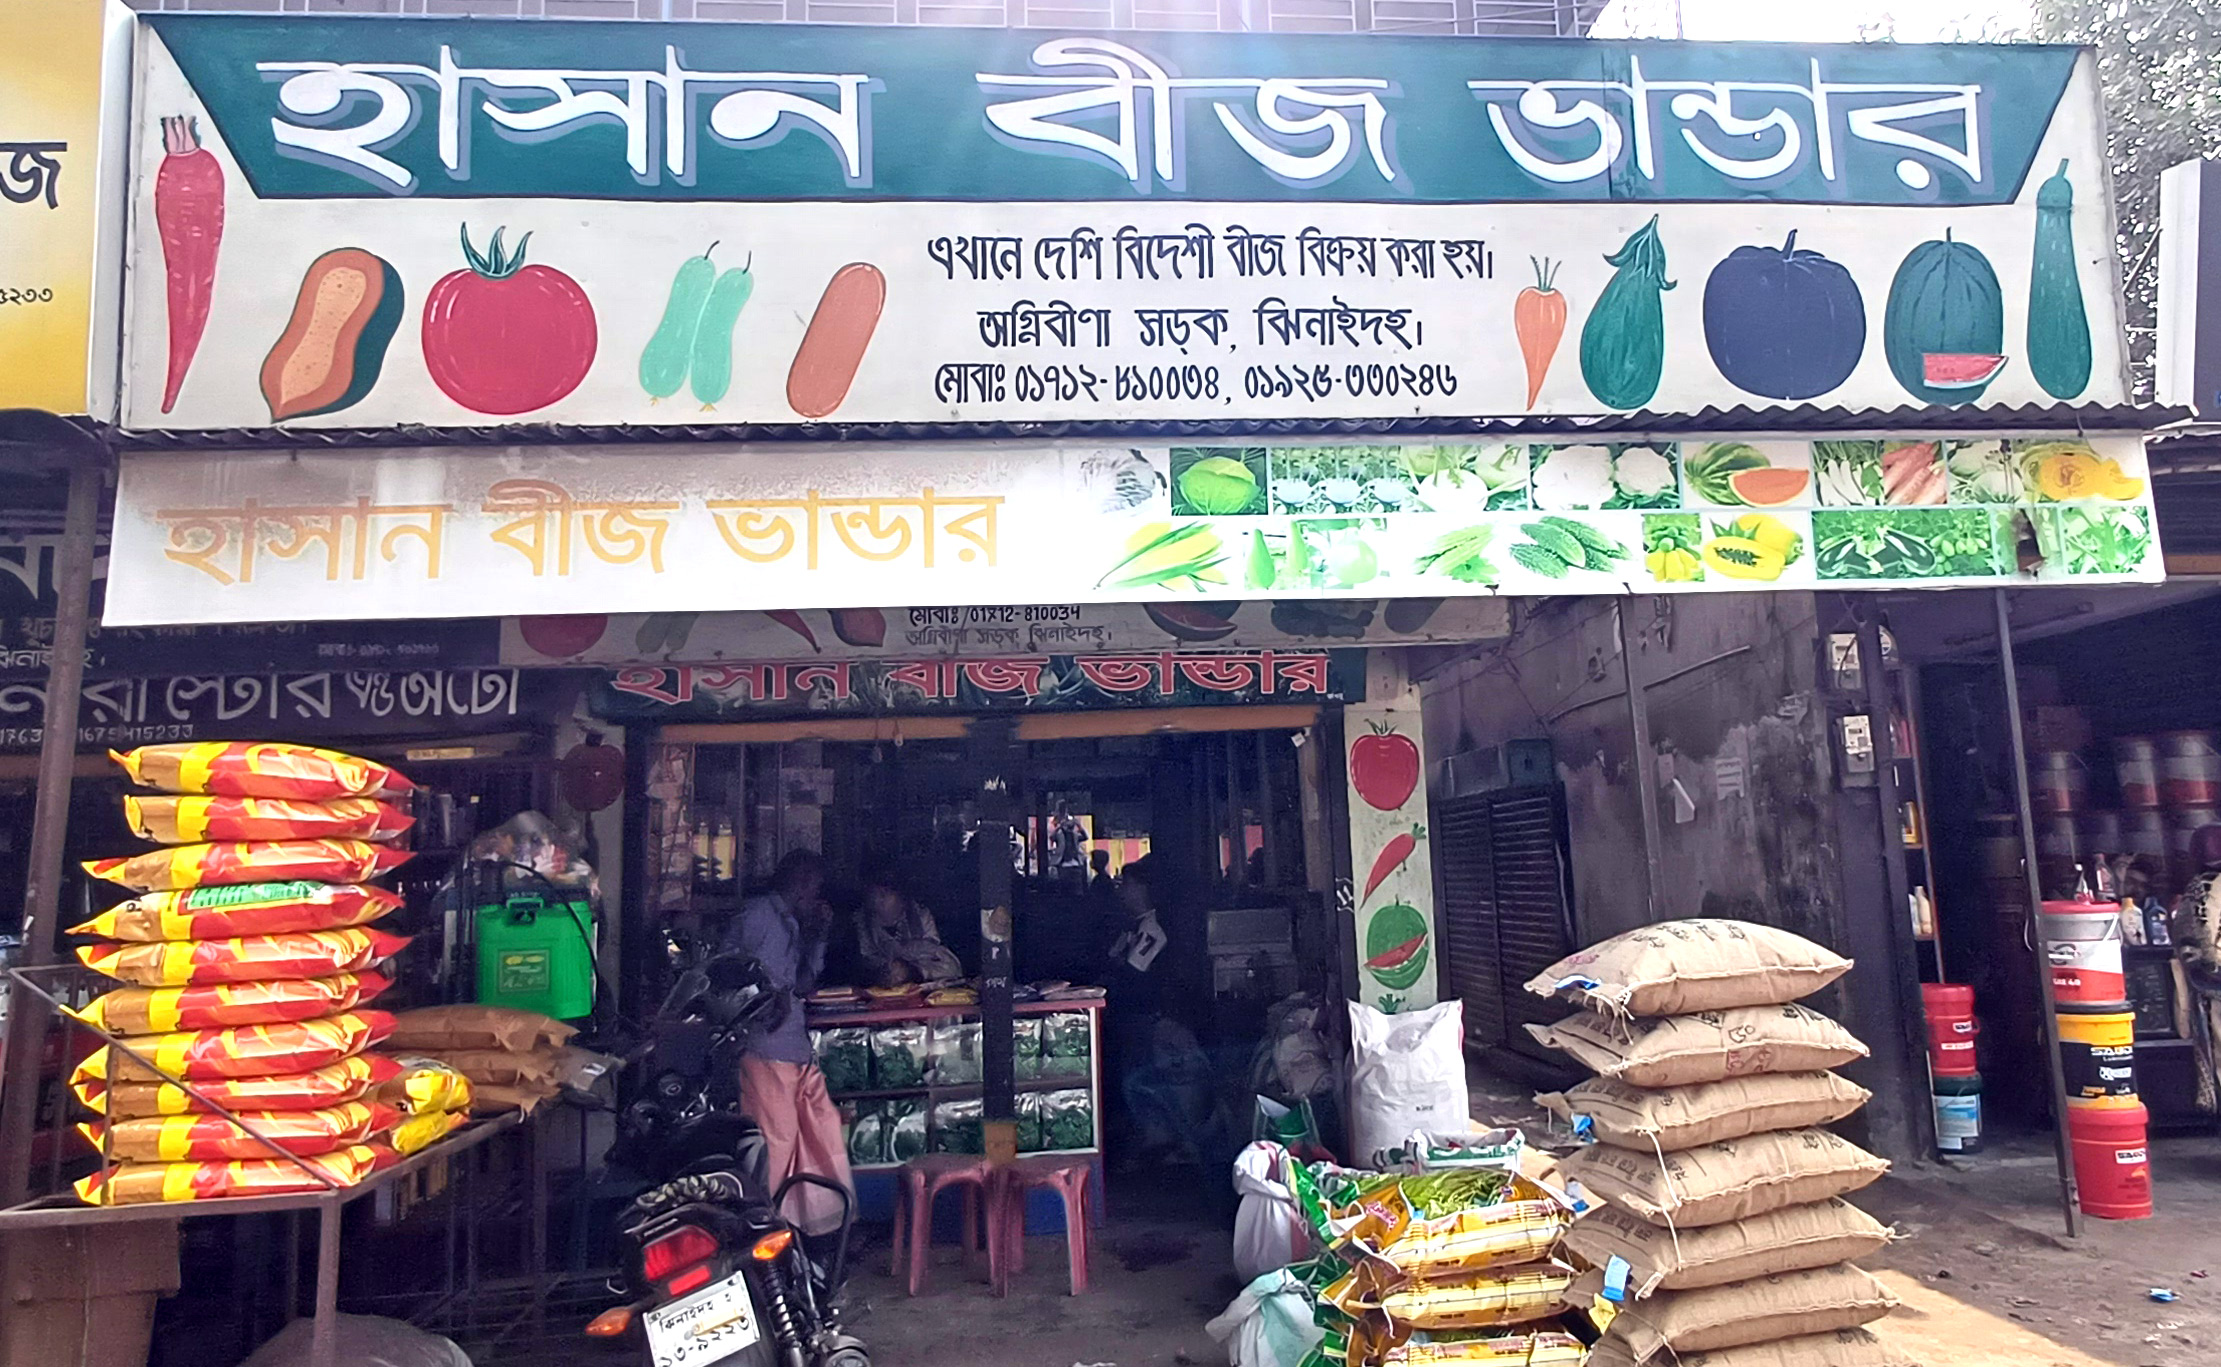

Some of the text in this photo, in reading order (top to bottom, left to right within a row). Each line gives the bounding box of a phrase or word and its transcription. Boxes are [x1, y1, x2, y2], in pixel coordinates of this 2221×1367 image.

[256, 37, 1990, 194] হাসান বীজ ভান্ডার
[927, 235, 1023, 281] এখানে
[1034, 226, 1104, 281] দেশি
[1112, 223, 1216, 281] বিদেশী
[1223, 224, 1287, 277] বীজ
[1296, 226, 1376, 277] বিক্রয়
[1381, 237, 1436, 279] করা
[976, 295, 1423, 355] অগ্নিবীণা সড়ক, ঝিনাইদহ।
[934, 363, 1006, 404] মোবাঃ
[1244, 363, 1458, 403] ০১৯২৫-৩৩০২৪৬
[156, 496, 453, 586] হাসান
[481, 478, 681, 578] বীজ
[706, 487, 1005, 570] ভান্ডার
[611, 659, 851, 705] হাসান
[1074, 650, 1330, 695] ভান্ডার
